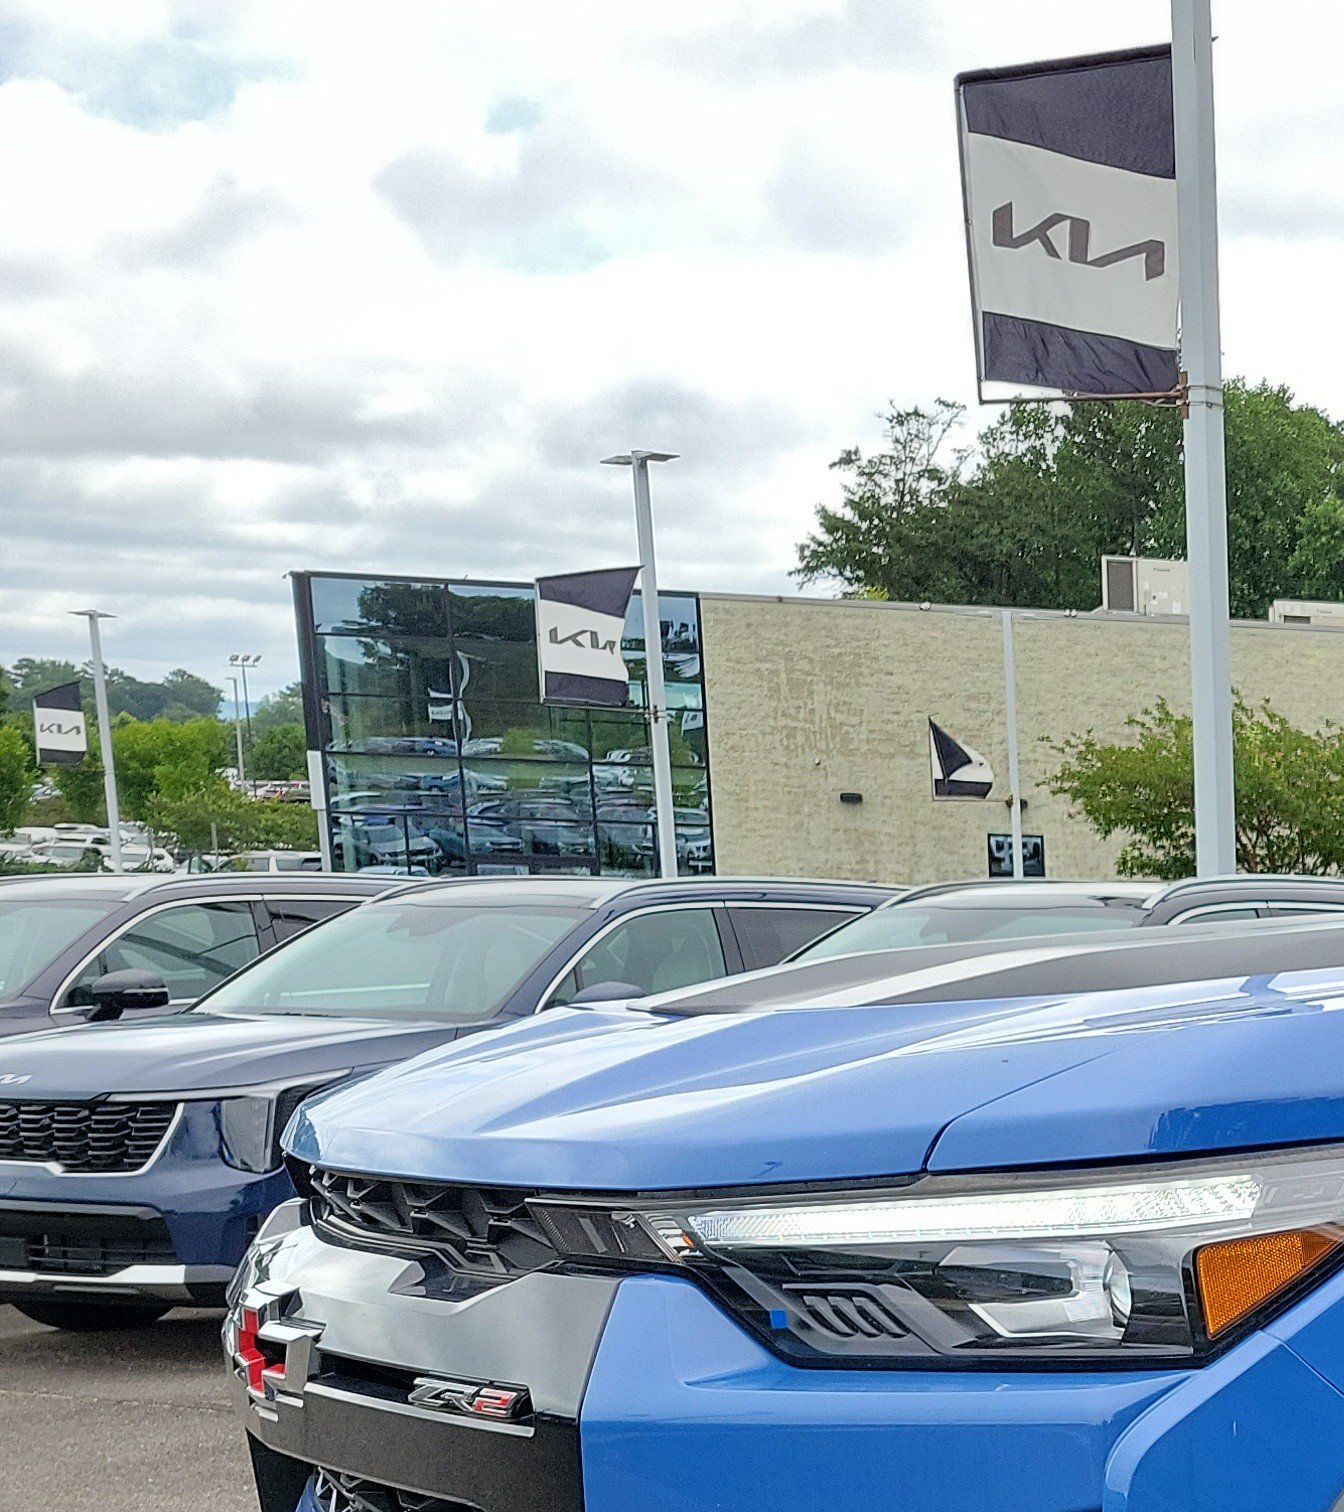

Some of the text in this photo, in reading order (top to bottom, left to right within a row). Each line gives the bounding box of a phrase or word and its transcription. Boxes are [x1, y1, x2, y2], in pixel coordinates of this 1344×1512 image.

[992, 201, 1165, 281] KIA
[548, 626, 616, 655] KIA
[39, 722, 82, 736] KIA
[407, 1376, 518, 1418] ZR2
